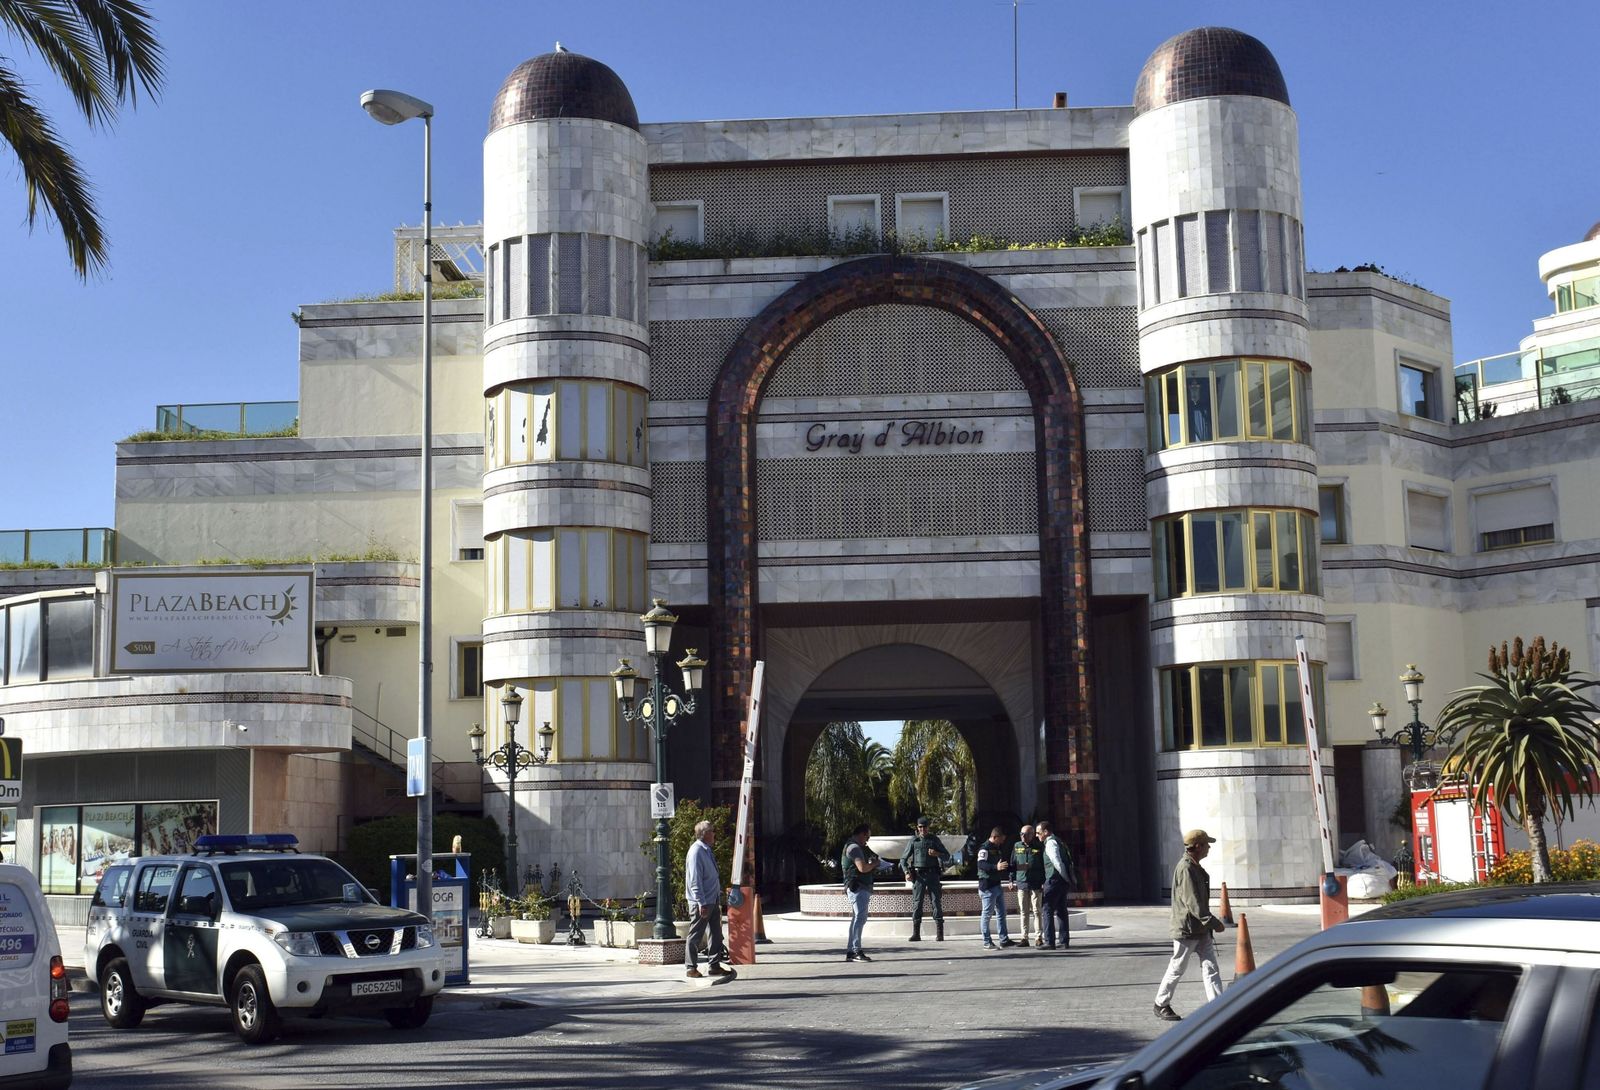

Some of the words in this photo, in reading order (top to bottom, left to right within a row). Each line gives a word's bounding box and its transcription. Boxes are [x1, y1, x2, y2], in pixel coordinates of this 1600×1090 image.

[806, 423, 865, 454] Gray
[901, 420, 984, 447] Albion
[431, 892, 454, 903] OGA
[131, 929, 154, 938] GUARDIA
[136, 940, 148, 949] CIVIL
[356, 980, 401, 994] PGC5225N
